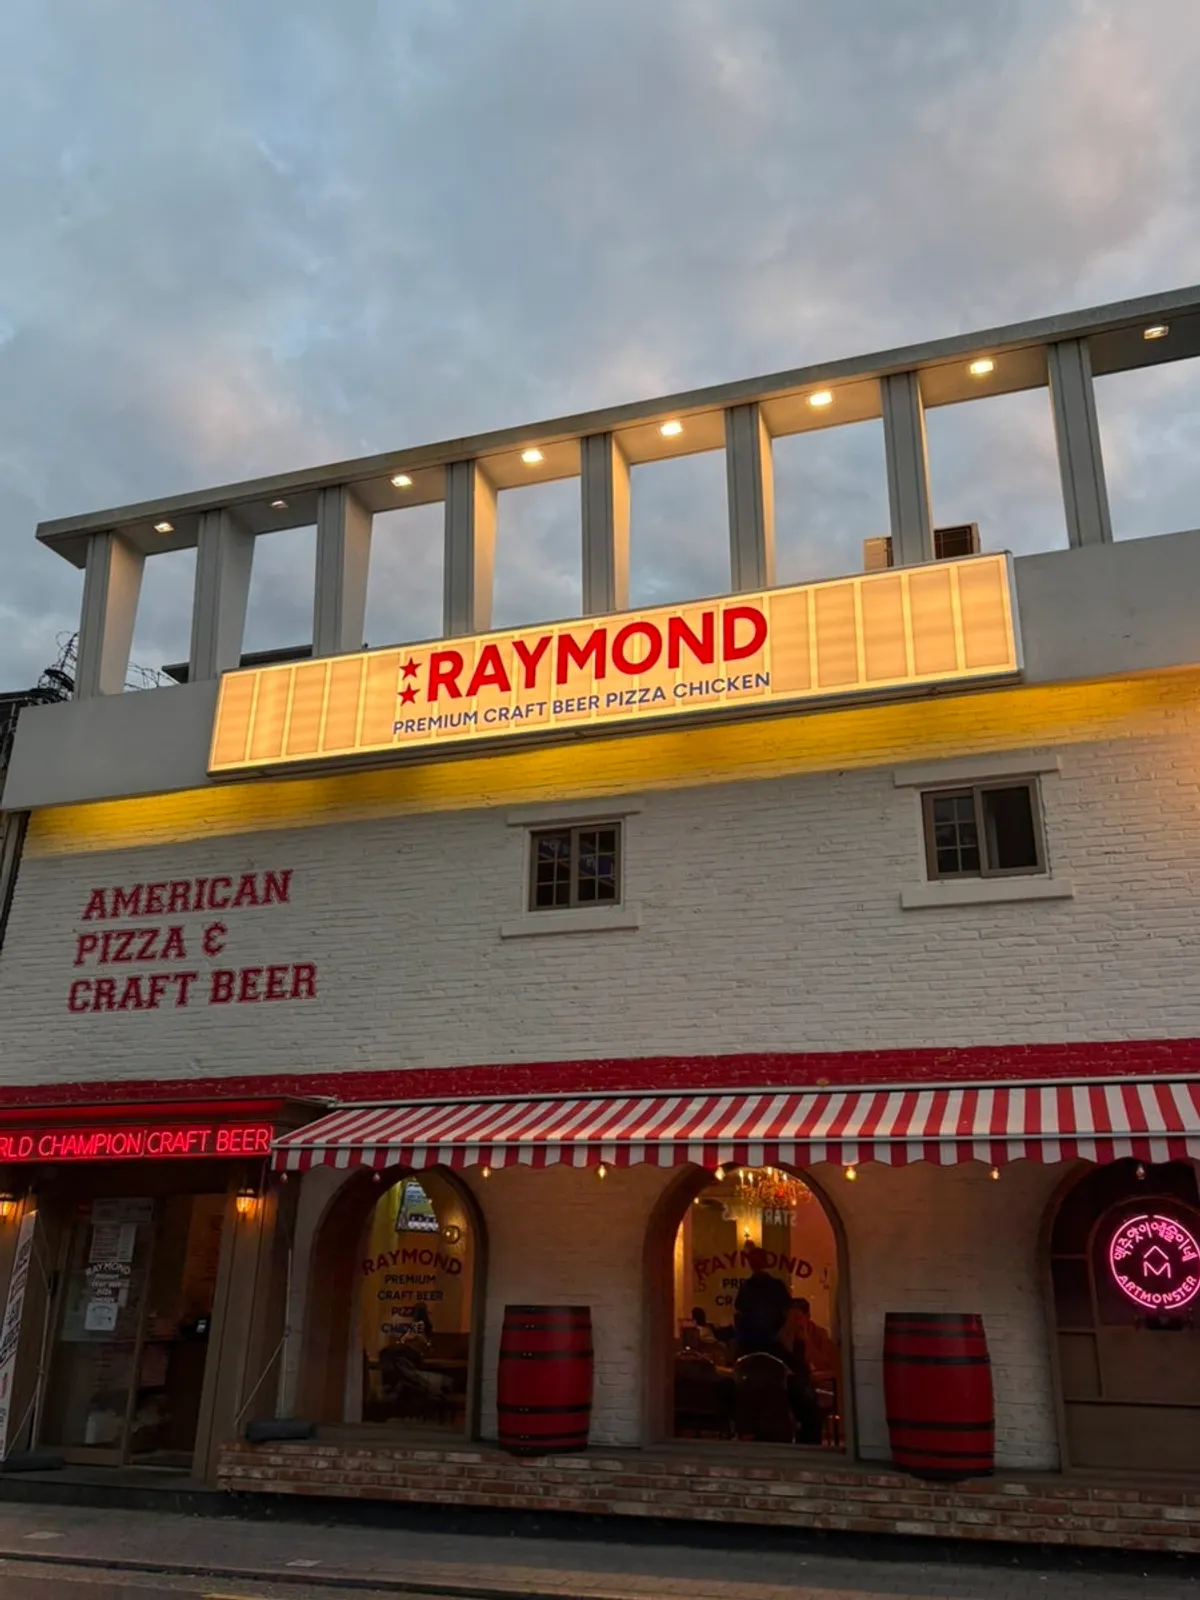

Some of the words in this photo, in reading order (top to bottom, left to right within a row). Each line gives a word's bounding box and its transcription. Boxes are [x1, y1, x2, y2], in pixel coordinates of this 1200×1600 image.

[427, 606, 768, 702] RAYMOND
[393, 710, 478, 735] PREMIUM
[483, 701, 547, 723] CRAFT
[552, 694, 600, 715] BEER
[605, 686, 666, 708] PIZZA
[673, 672, 770, 699] CHICKEN
[82, 868, 294, 921] AMERICAN
[73, 924, 187, 967] PIZZA
[67, 969, 200, 1013] CRAFT
[208, 961, 318, 1005] BEER
[38, 1131, 142, 1156] CHAMPION
[147, 1130, 212, 1154] CRAFT
[216, 1128, 269, 1152] BEER
[361, 1248, 462, 1276] RAYMOND
[383, 1273, 437, 1285] PREMIUM
[1117, 1275, 1197, 1304] ARTMONSTER
[377, 1289, 413, 1301] CRAFT
[416, 1289, 444, 1301] BEER
[391, 1306, 417, 1317] PIZZ
